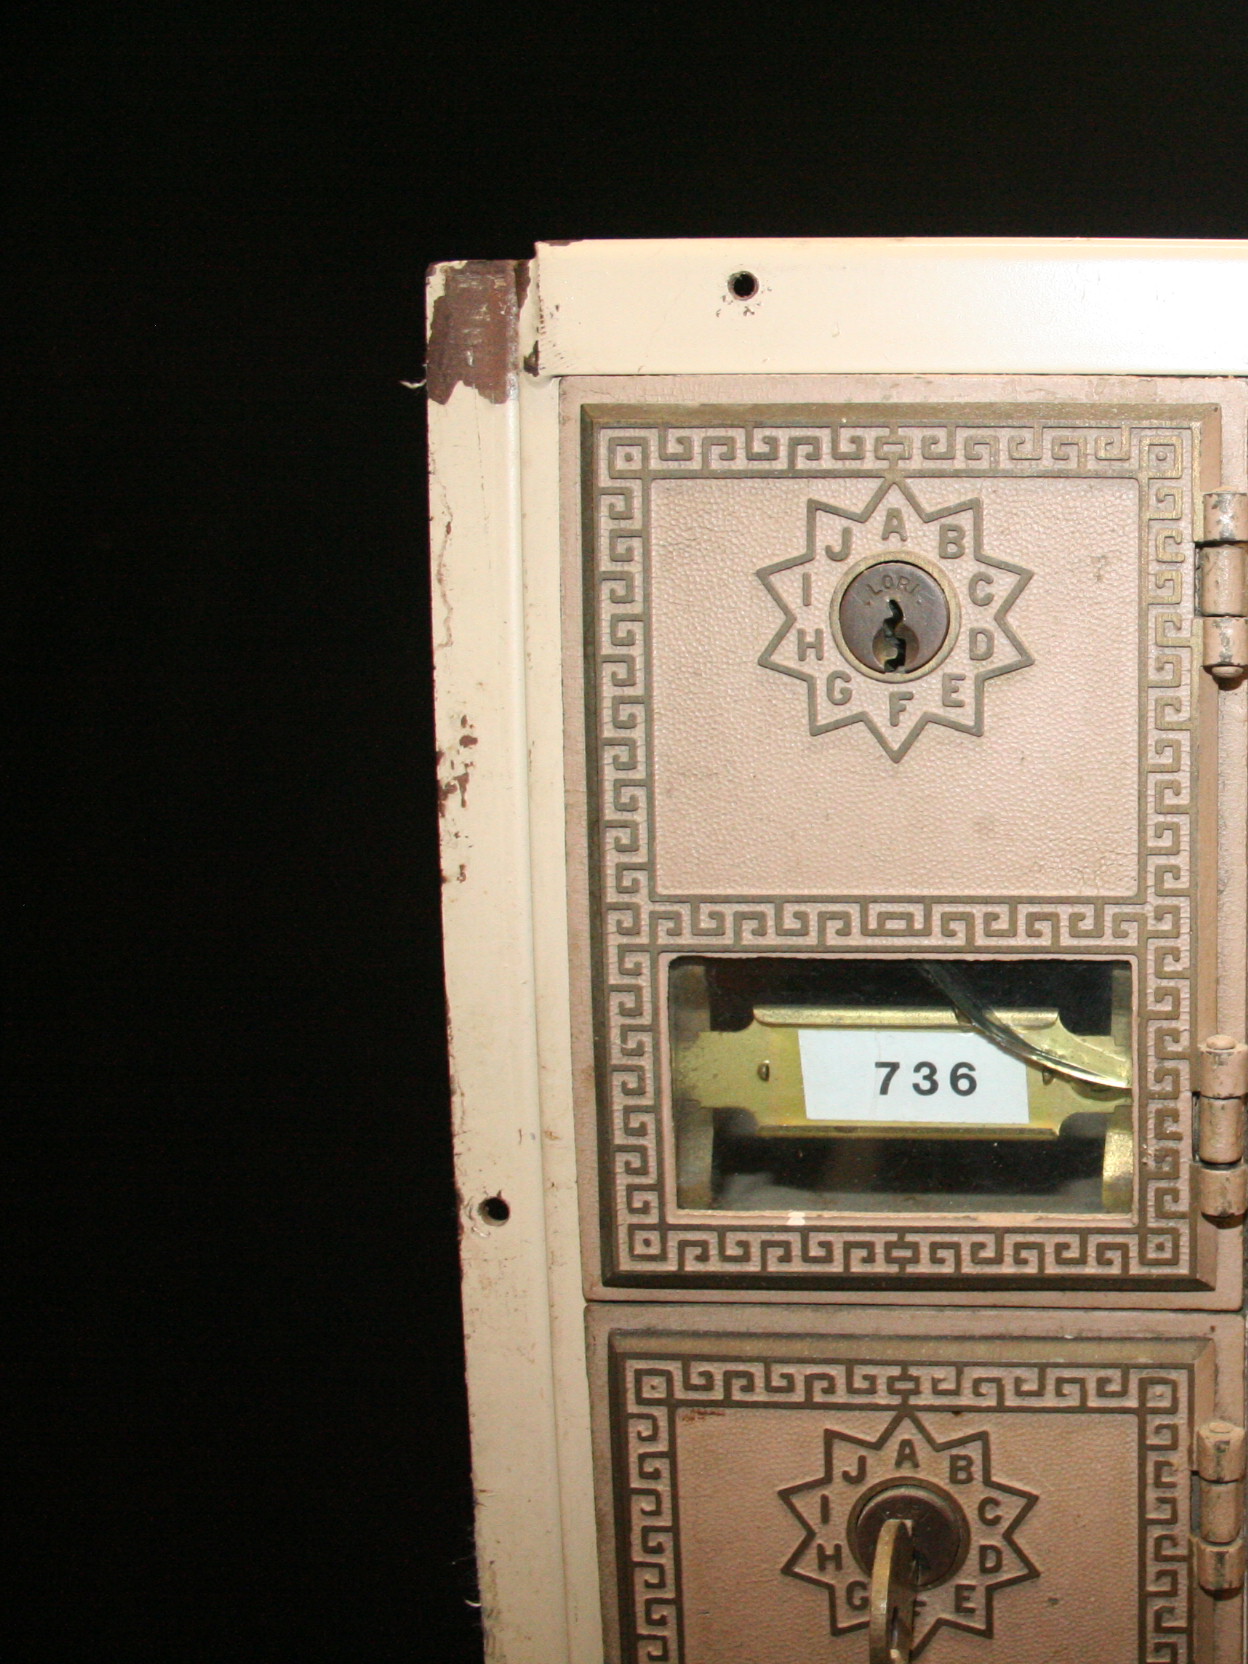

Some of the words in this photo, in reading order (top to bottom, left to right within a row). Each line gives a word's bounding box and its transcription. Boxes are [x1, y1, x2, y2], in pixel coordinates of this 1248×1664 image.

[881, 508, 907, 542] A
[825, 526, 852, 561] J
[939, 524, 966, 559] B
[802, 572, 812, 606] I
[968, 572, 994, 606] C
[797, 628, 824, 661] H
[969, 628, 994, 660] D
[826, 670, 852, 706] G
[942, 672, 966, 708] E
[890, 691, 914, 727] F
[874, 1061, 978, 1097] 736
[842, 1455, 867, 1484] J
[895, 1439, 920, 1469] A
[949, 1454, 974, 1484] B
[820, 1493, 830, 1524] I
[977, 1496, 1002, 1526] C
[817, 1543, 842, 1572] H
[979, 1544, 1003, 1574] D
[846, 1581, 870, 1611] G
[955, 1584, 976, 1614] E
